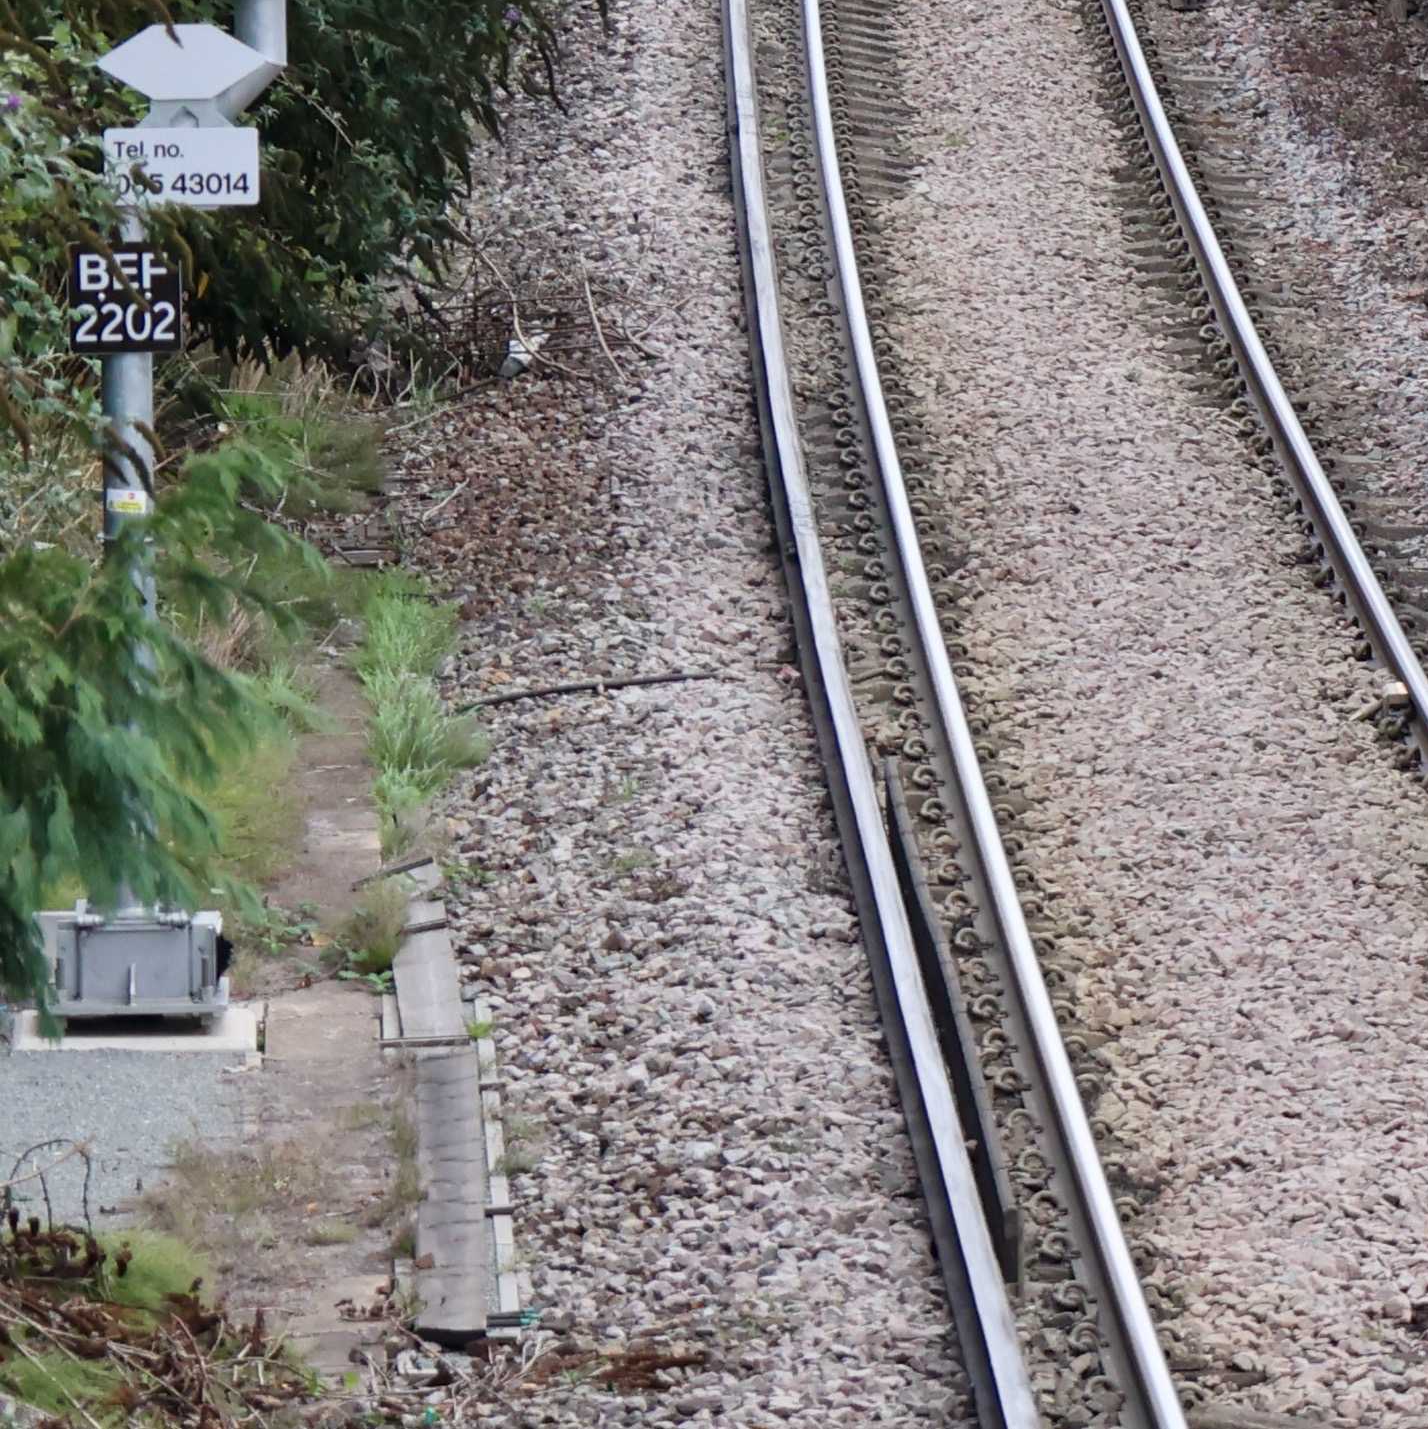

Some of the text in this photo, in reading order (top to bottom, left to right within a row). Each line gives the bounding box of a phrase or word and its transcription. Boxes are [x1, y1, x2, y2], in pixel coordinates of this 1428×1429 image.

[154, 143, 184, 158] no.
[116, 173, 250, 195] 05 43014
[79, 253, 167, 291] BEF
[75, 301, 175, 342] 2202
